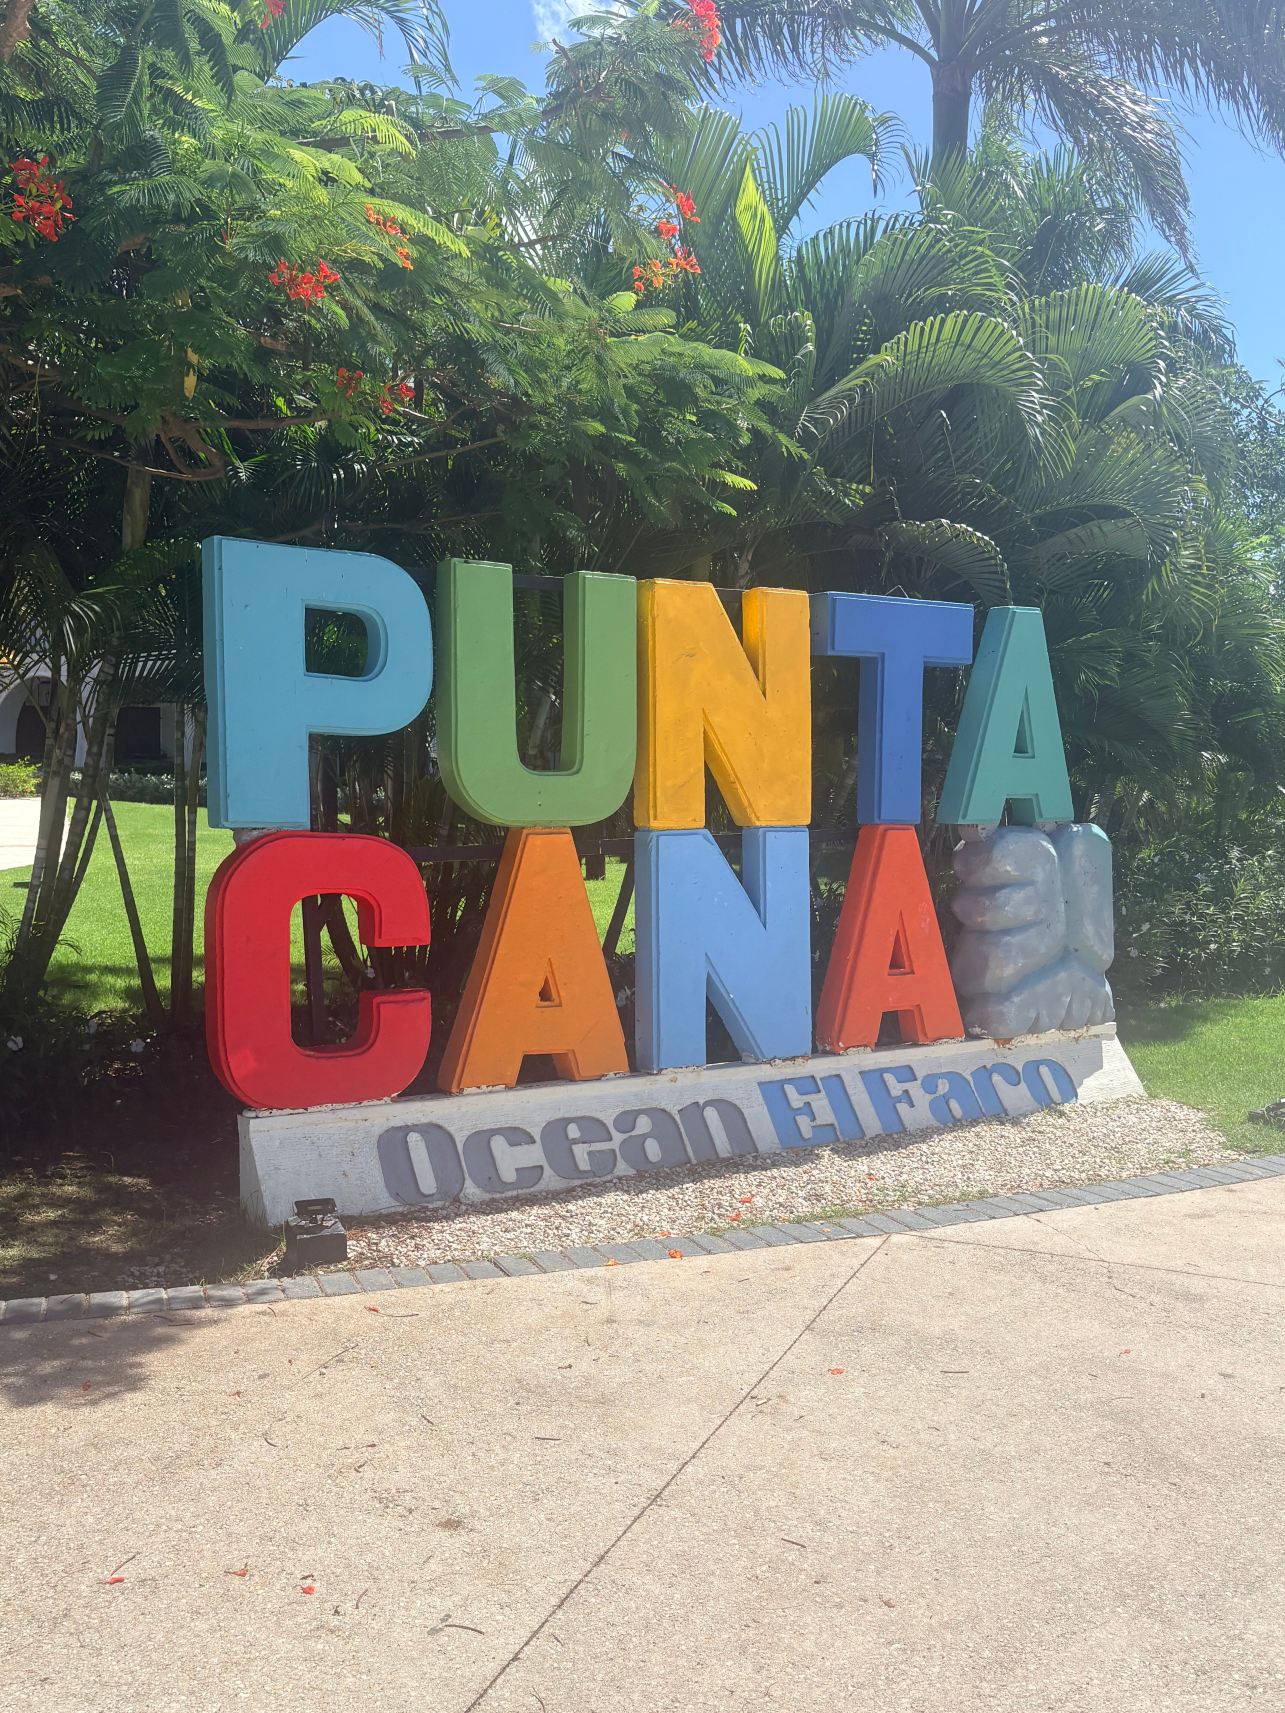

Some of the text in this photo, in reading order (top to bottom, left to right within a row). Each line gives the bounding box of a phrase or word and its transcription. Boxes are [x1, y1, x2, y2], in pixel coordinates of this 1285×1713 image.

[202, 535, 1074, 829] PUNTA
[204, 826, 965, 1110] CANA
[377, 1058, 1079, 1203] Ocean El Faro
